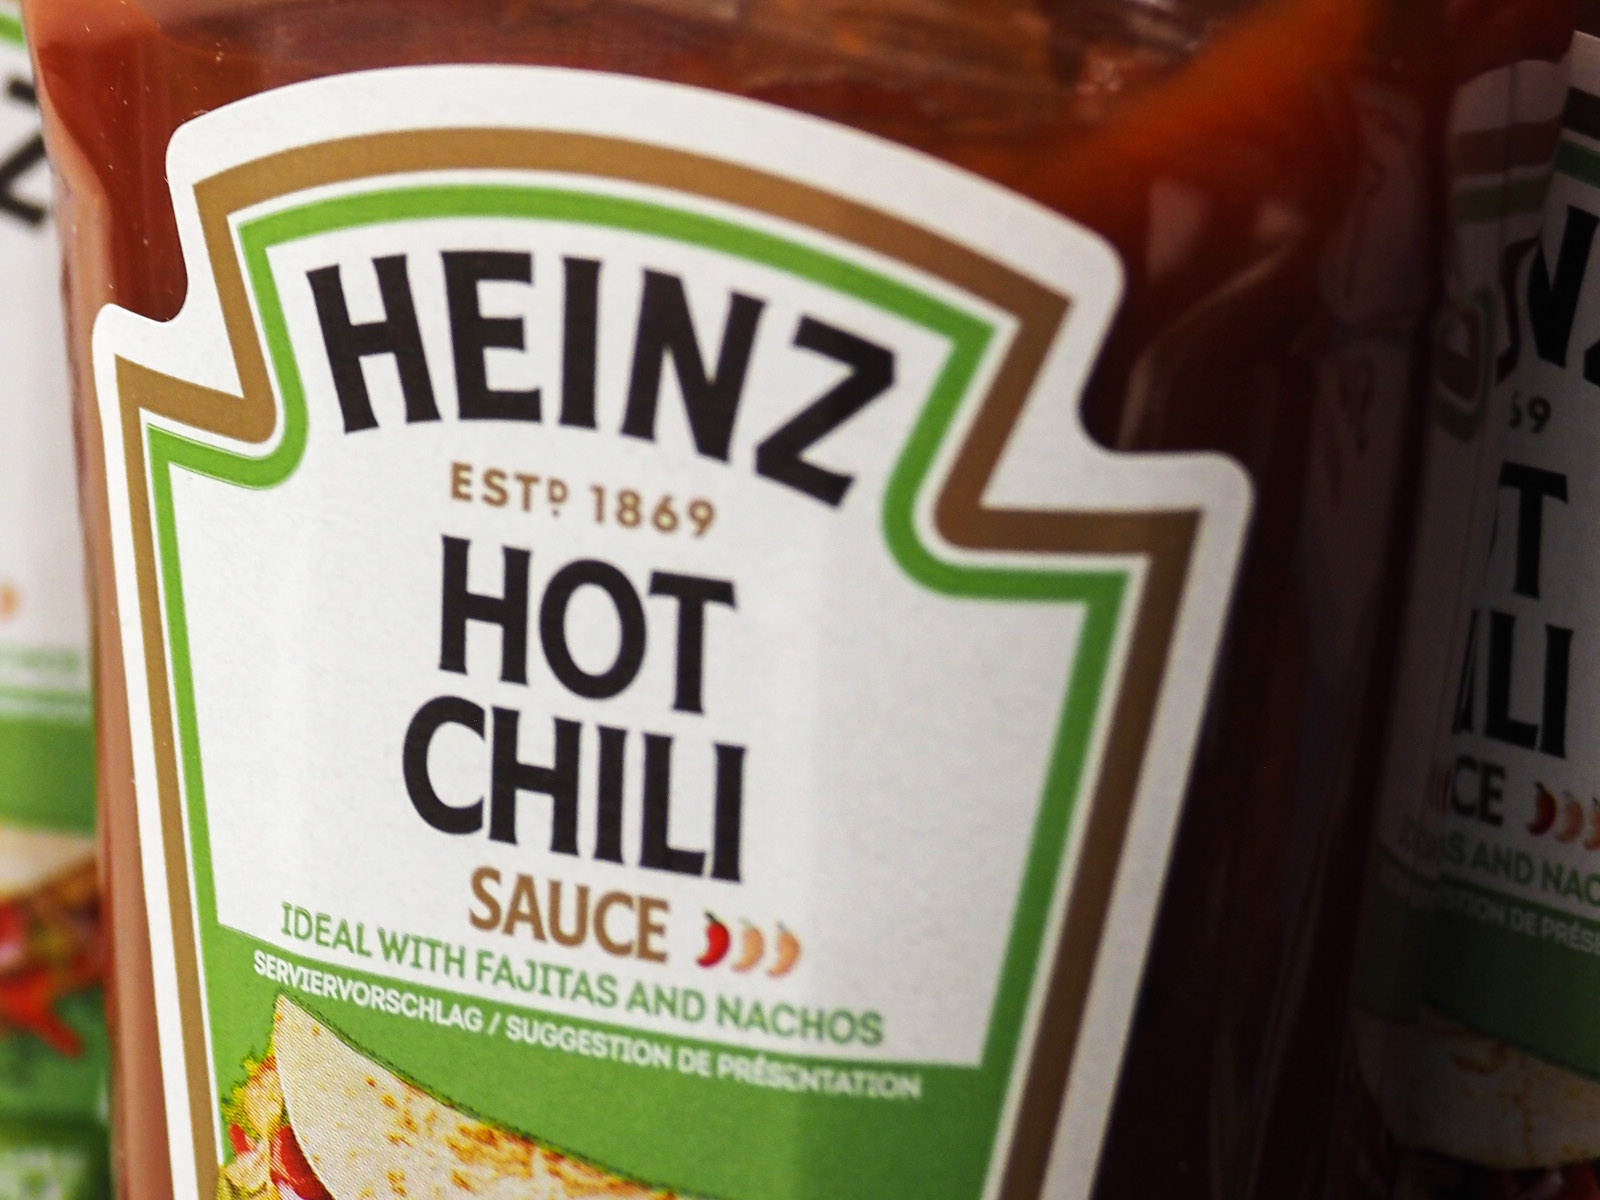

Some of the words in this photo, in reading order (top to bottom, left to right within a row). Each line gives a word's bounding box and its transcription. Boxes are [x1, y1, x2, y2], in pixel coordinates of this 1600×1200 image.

[306, 250, 896, 509] HEINZ
[590, 483, 716, 538] 1869
[439, 535, 739, 715] HOT
[402, 696, 747, 883] CHILI
[281, 900, 373, 958] IDEAL
[377, 926, 466, 979] WITH
[476, 948, 618, 1008] FAJITAS
[626, 979, 706, 1023] AND
[716, 994, 884, 1047] NACHOS
[469, 865, 672, 964] SAUCE
[254, 950, 484, 1034] SERVIERVORSCHLAG
[505, 1013, 672, 1070] SUGGESTION
[677, 1045, 713, 1078] DE
[717, 1054, 924, 1100] PRÉSENTATION
